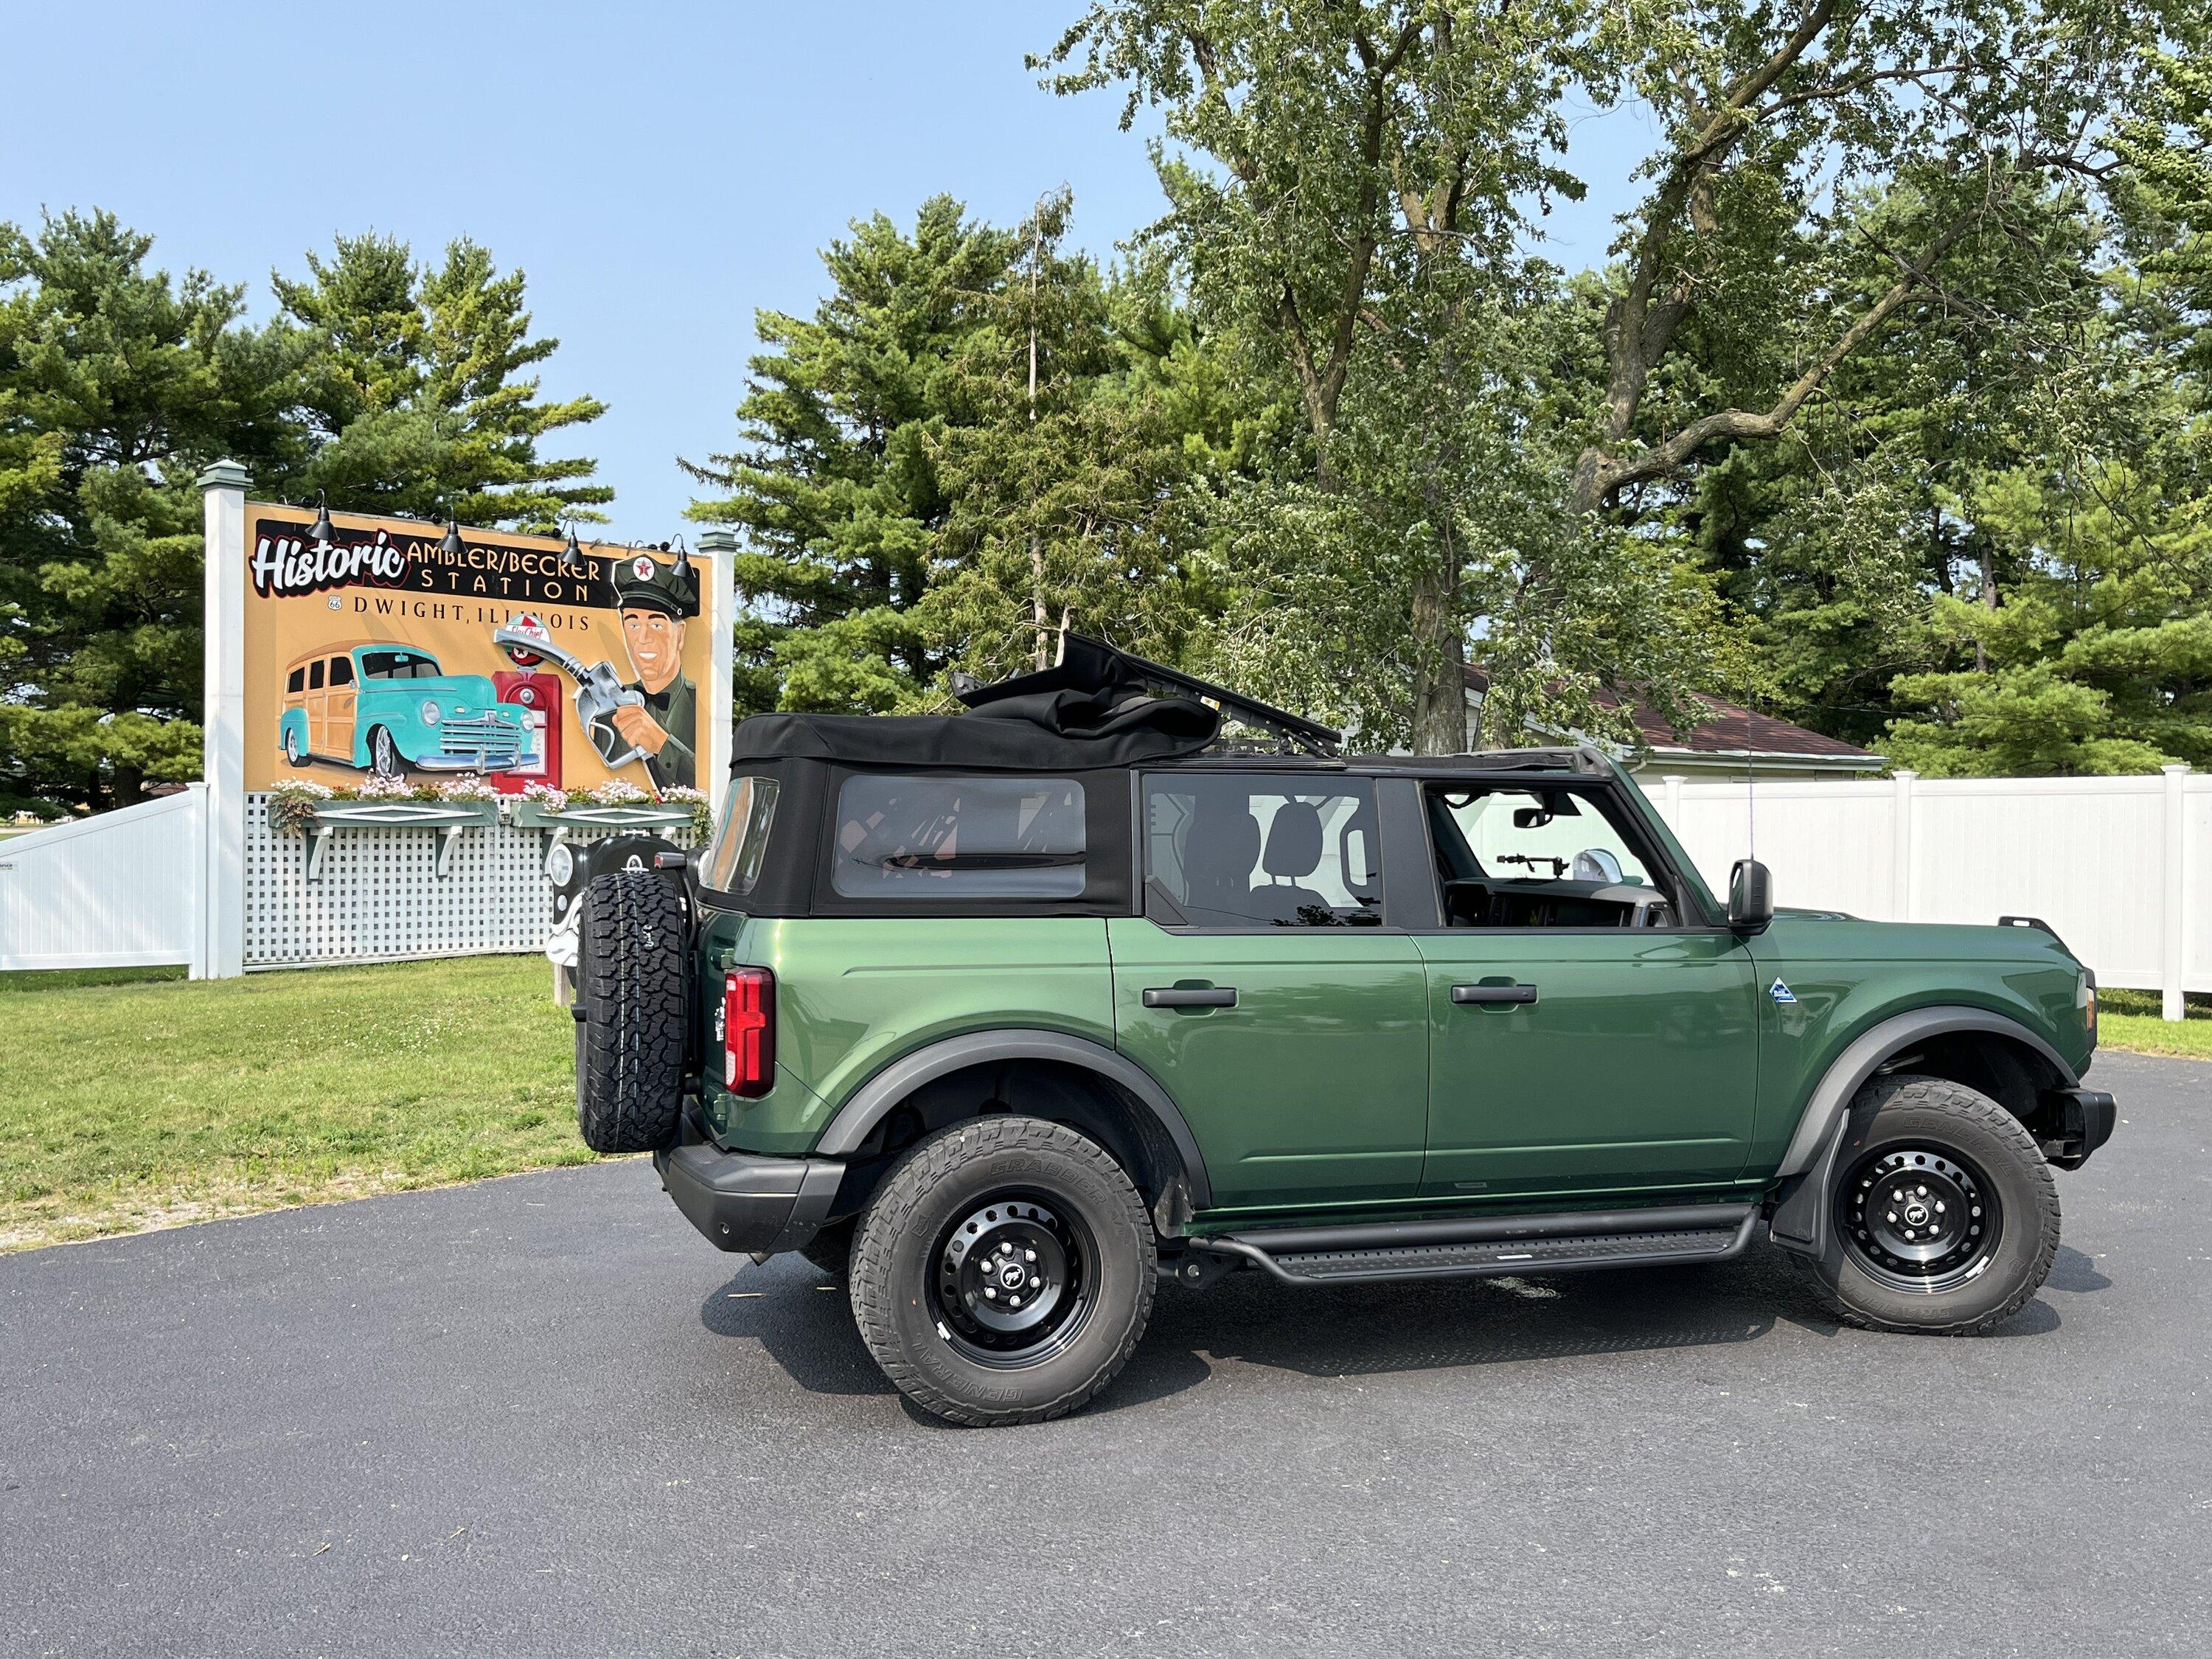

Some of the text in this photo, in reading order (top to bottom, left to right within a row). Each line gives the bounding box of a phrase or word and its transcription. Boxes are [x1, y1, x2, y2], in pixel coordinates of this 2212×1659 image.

[251, 531, 406, 590] Historic
[407, 541, 600, 581] AMBLER/BECKER
[421, 568, 588, 602] STATION
[354, 597, 589, 631] DWIGHT, ILLOIS
[1904, 1116, 2013, 1178] GENERAL
[990, 1158, 1107, 1205] GRABBER
[911, 1325, 1024, 1402] GENERAL
